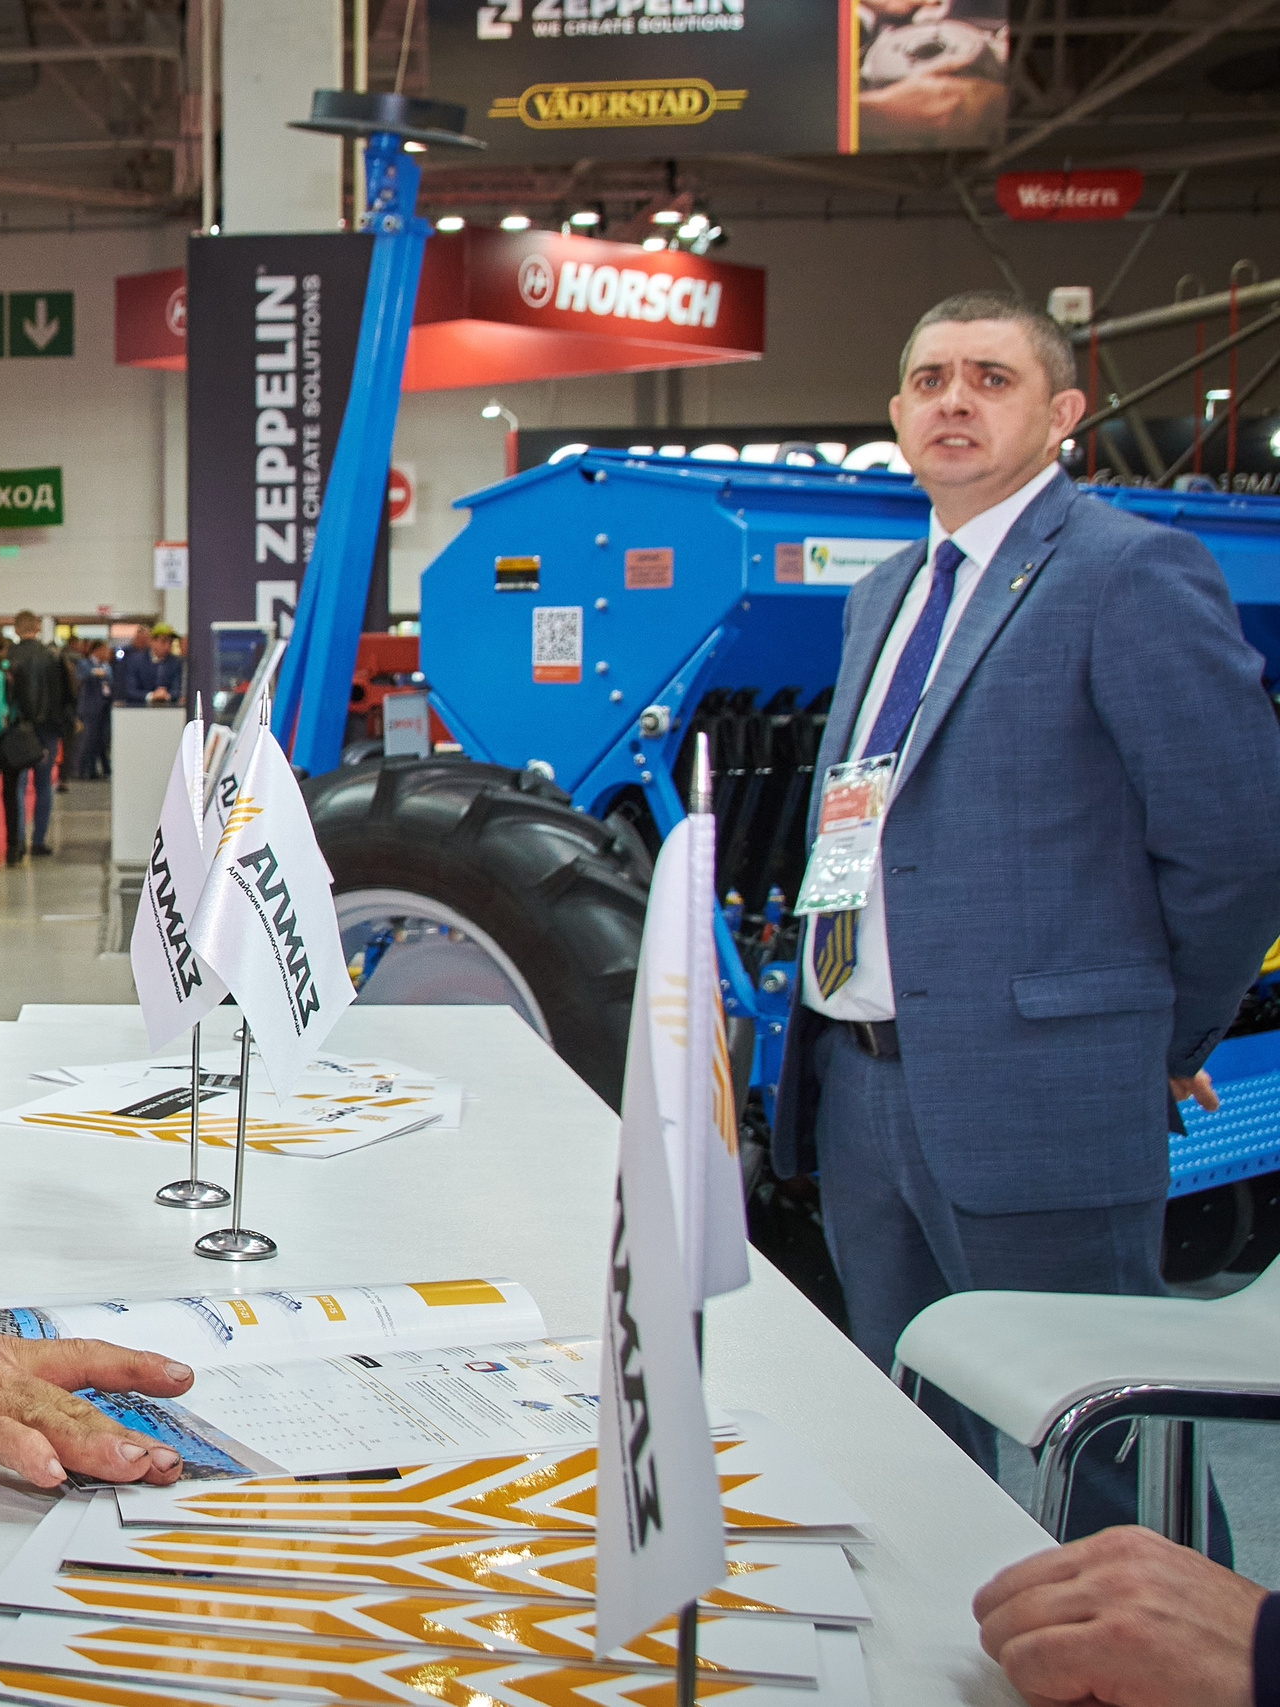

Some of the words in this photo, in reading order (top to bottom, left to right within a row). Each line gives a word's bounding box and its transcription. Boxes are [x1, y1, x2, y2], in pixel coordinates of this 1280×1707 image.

[532, 20, 562, 38] WE
[564, 16, 635, 36] CREATE
[637, 13, 745, 34] SOLUTIONS
[1017, 183, 1118, 209] Western
[302, 274, 322, 418] SOLUTIONS
[554, 261, 721, 329] HORSCH
[255, 274, 297, 564] ZEPPELIN
[302, 422, 321, 520] CREATE
[226, 865, 261, 911] Алтайские
[258, 908, 294, 1007] машиностроительные
[236, 842, 320, 1029] АЛМАЗ
